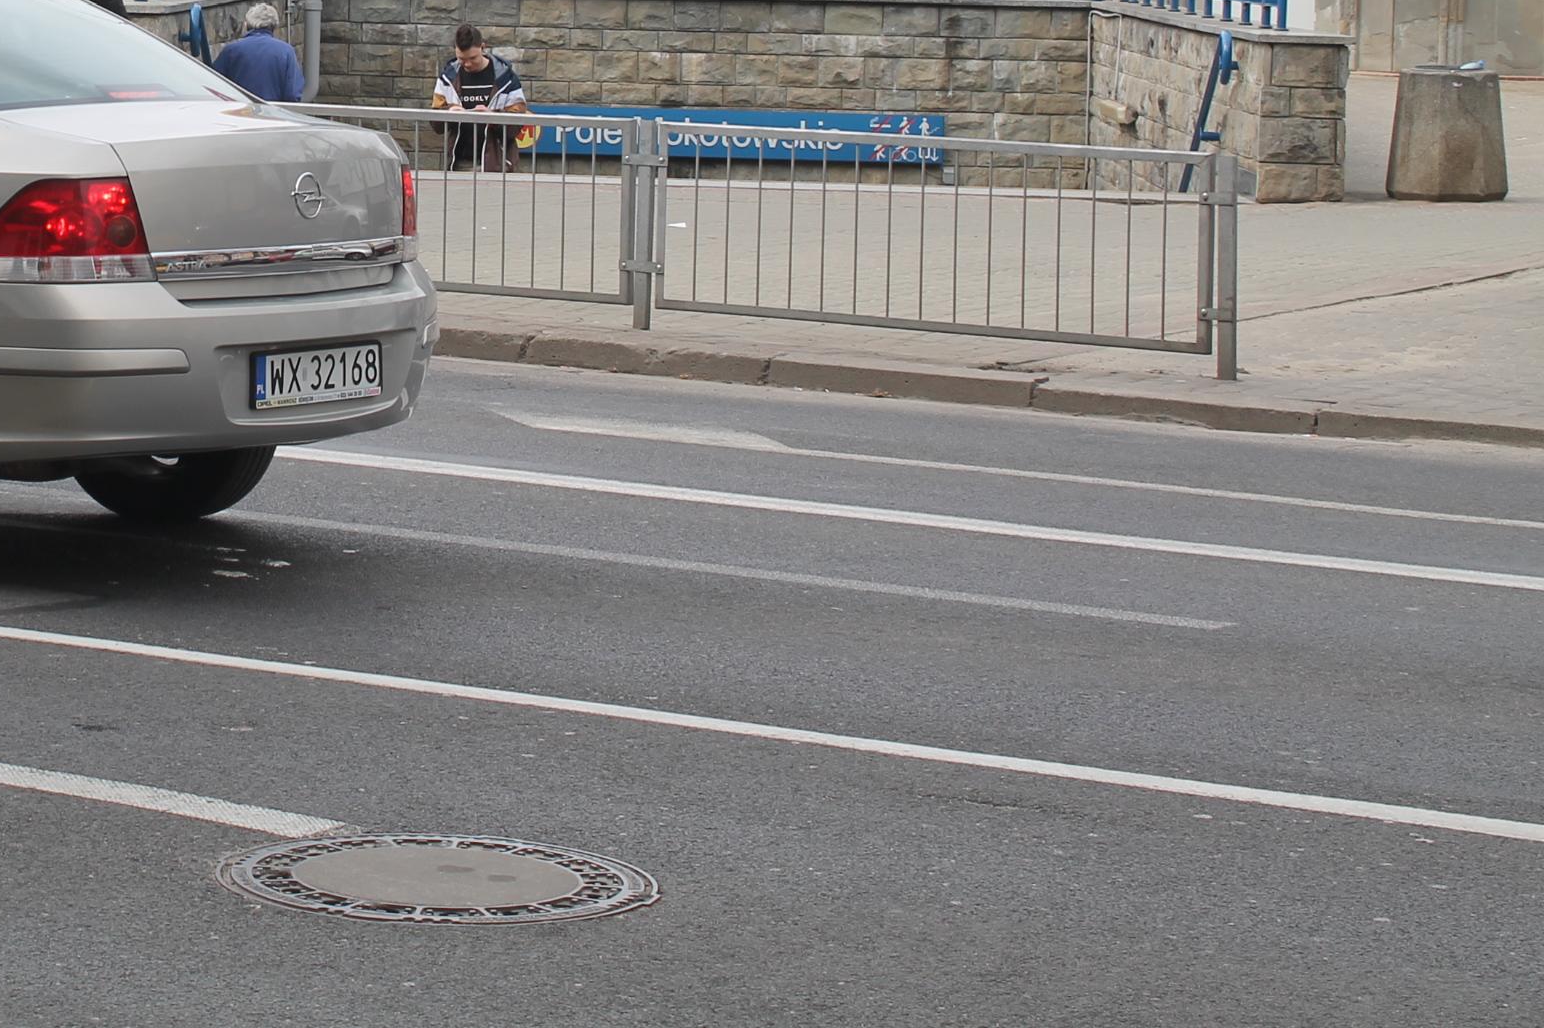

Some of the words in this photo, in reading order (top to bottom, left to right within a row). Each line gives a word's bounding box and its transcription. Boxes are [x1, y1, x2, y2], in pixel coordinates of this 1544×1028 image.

[167, 261, 208, 272] ASTRA
[271, 356, 302, 396] WX
[310, 348, 377, 390] 32168
